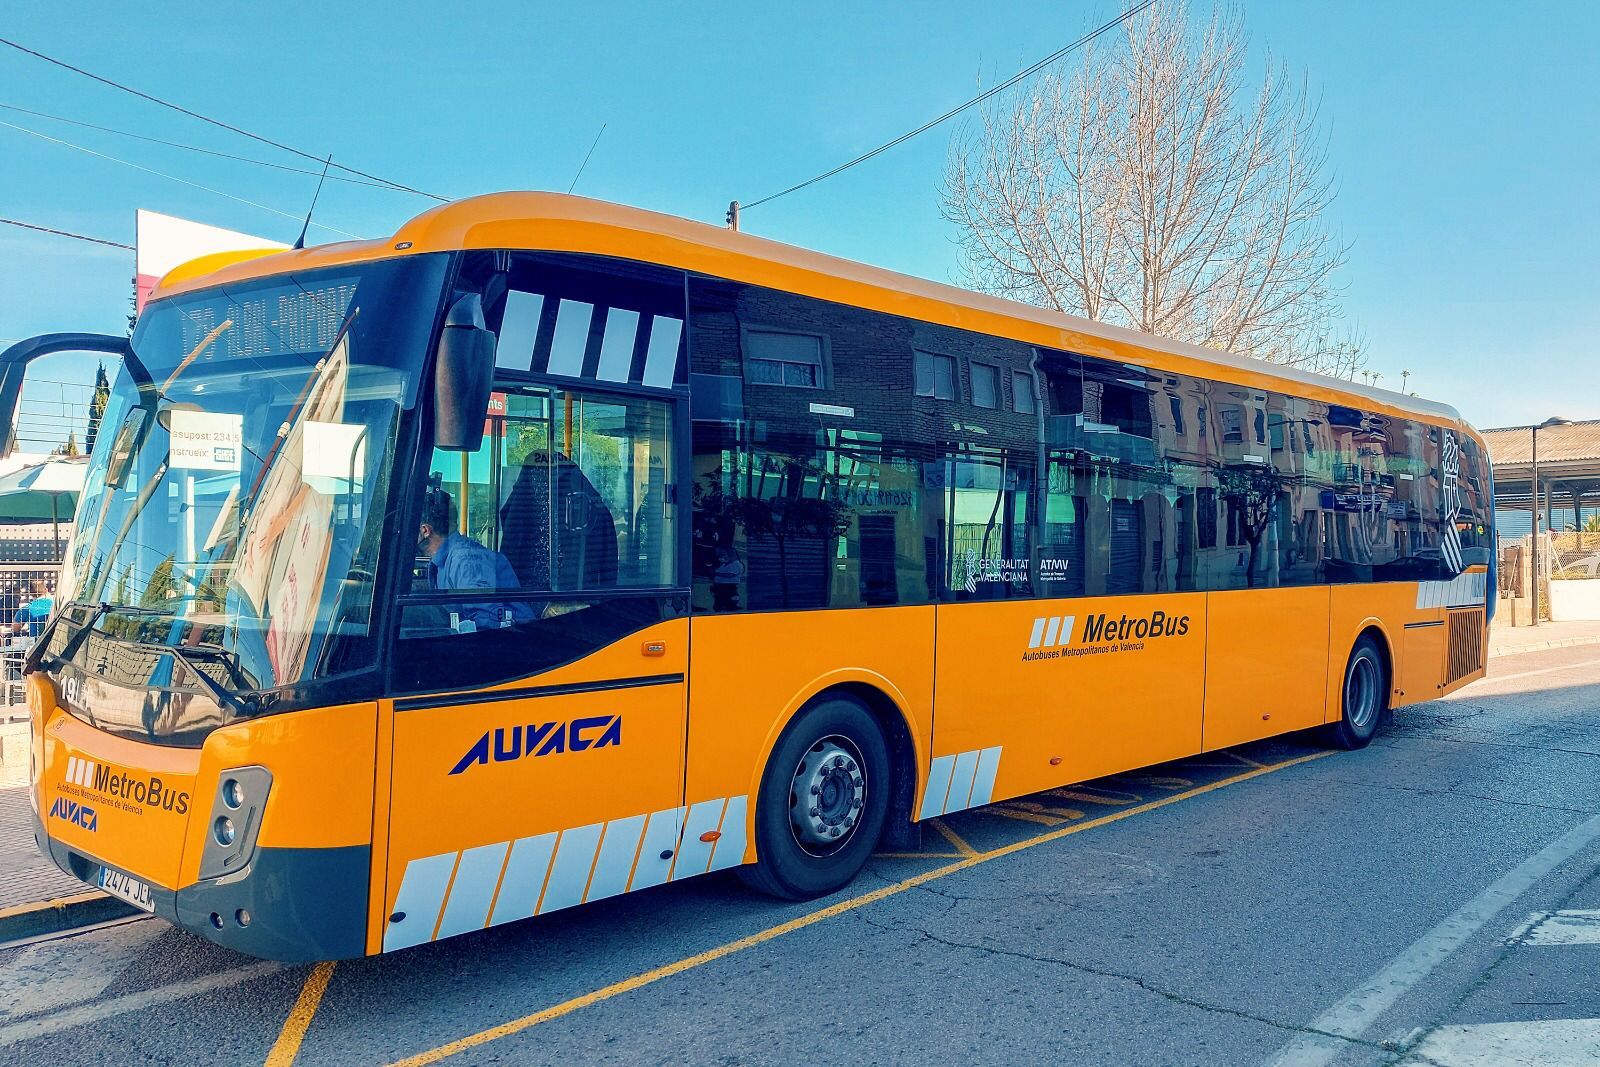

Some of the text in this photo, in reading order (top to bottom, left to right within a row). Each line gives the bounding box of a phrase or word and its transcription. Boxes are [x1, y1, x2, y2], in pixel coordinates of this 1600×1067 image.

[979, 559, 1030, 570] GENERALITAT
[980, 571, 1029, 582] VALENCIANA
[1039, 559, 1069, 571] ATMV
[1082, 610, 1190, 644] MetroBus
[1021, 640, 1145, 662] Autobuses Metropolitanos de Valencia
[447, 715, 622, 776] AUVACA
[56, 782, 143, 815] Autobuses Metropolitanos de Valencia
[93, 763, 190, 814] MetroBus
[49, 796, 97, 833] AUVACA
